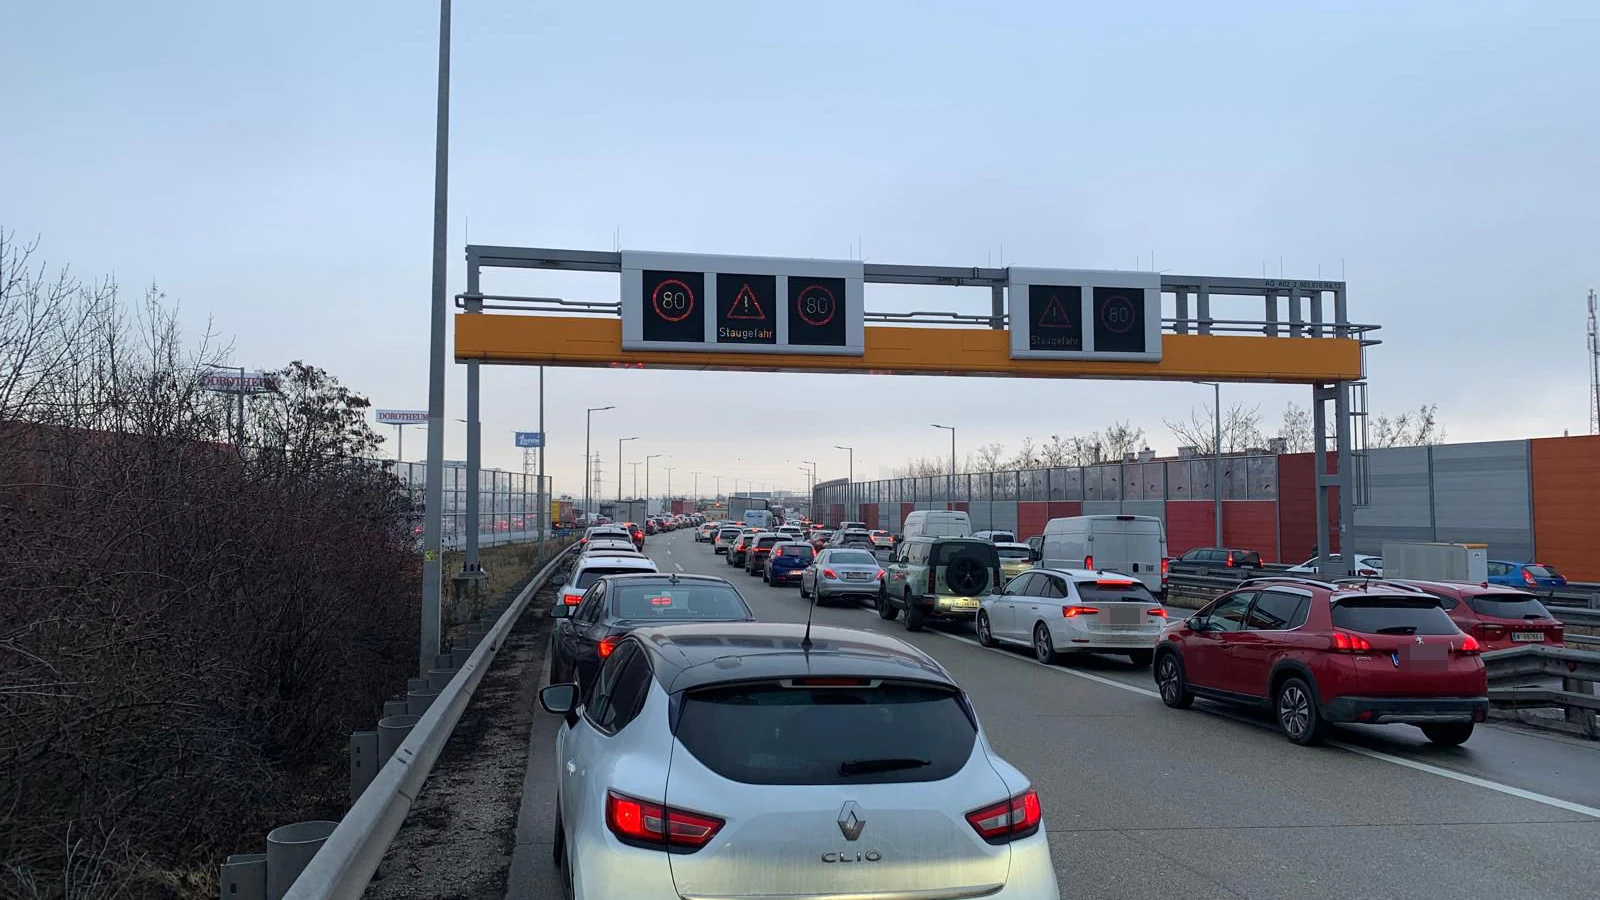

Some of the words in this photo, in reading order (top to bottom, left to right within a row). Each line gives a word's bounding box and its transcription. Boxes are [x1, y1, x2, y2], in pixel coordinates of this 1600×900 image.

[662, 291, 685, 309] 80
[806, 297, 828, 314] 80
[1108, 306, 1129, 323] 80
[719, 326, 773, 340] Staugefahr
[1030, 335, 1080, 347] Staugefahr
[821, 849, 882, 863] CLIO
